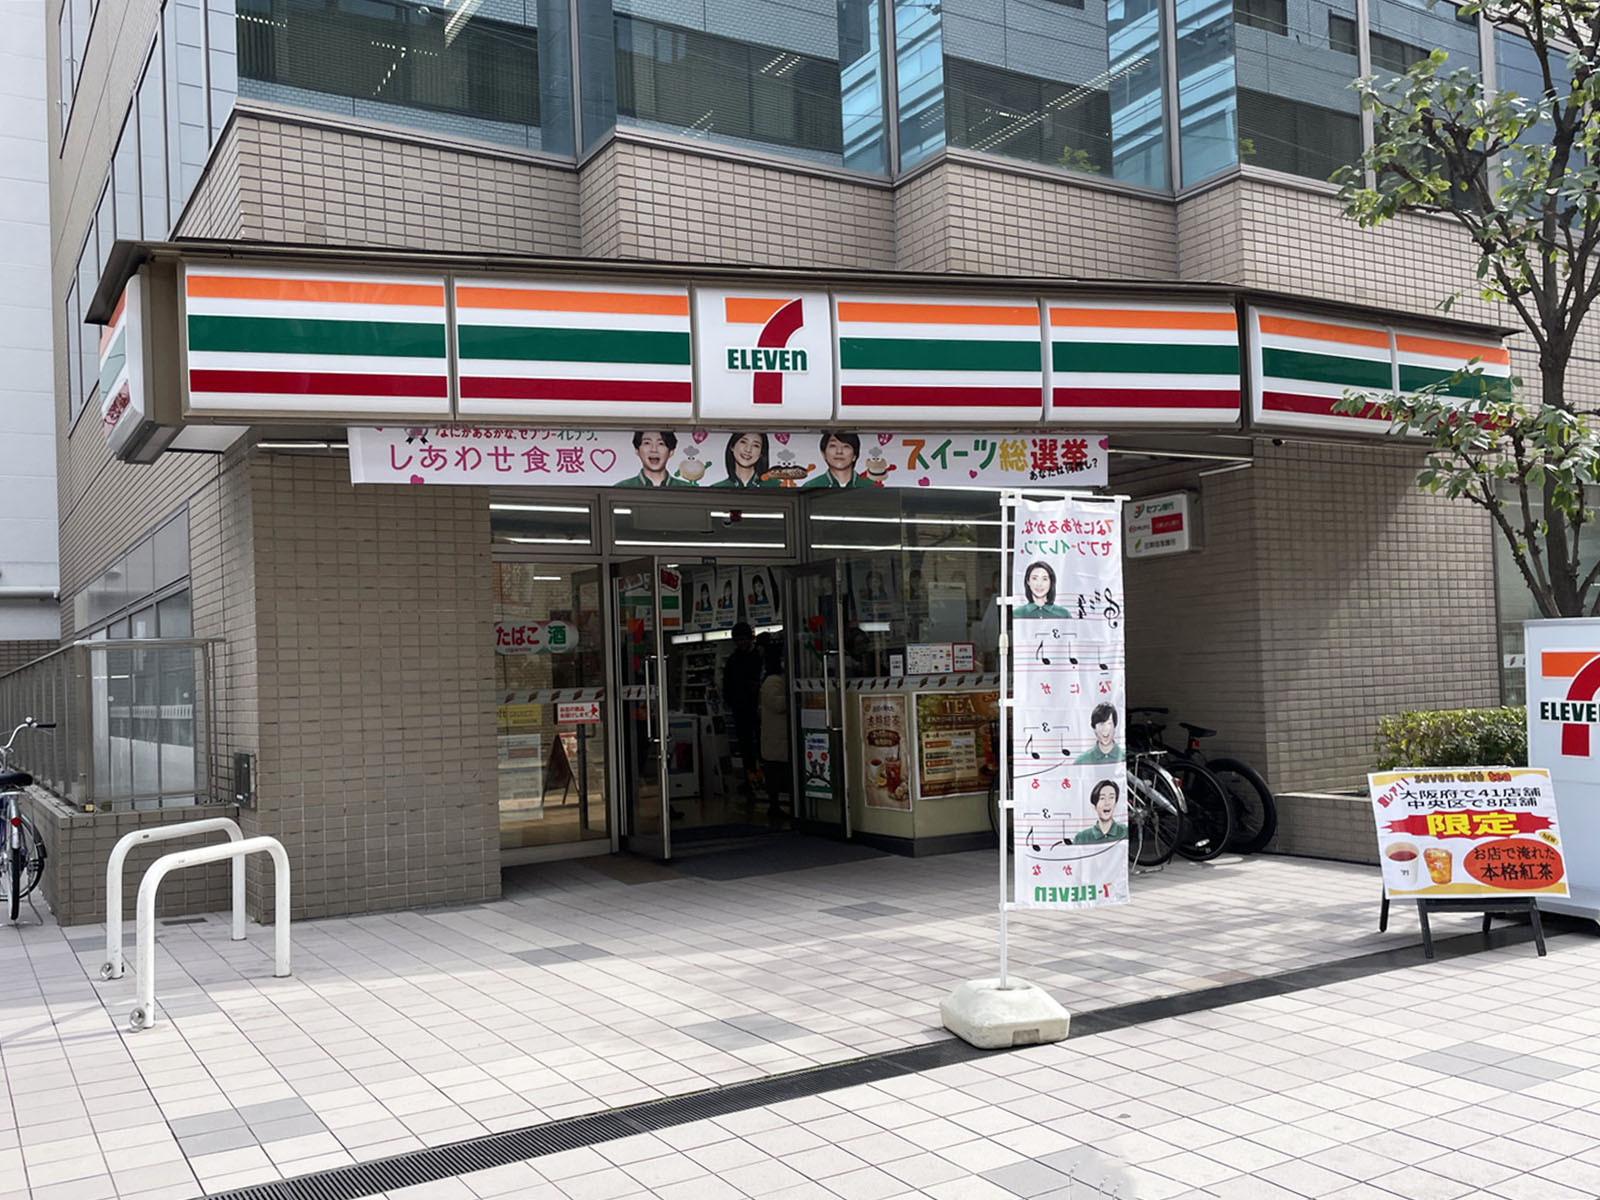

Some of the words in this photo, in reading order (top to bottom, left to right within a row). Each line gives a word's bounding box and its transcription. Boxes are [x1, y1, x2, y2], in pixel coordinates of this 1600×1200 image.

[389, 444, 585, 473] しあわせ食感
[902, 437, 1088, 472] スイーツ総選挙
[496, 626, 539, 646] たばこ
[548, 626, 566, 644] 酒
[942, 698, 976, 713] TEA
[1540, 702, 1600, 722] ELEVE
[1400, 788, 1541, 799] 大阪府で41店舗
[1407, 798, 1537, 809] 中央区で8店舗
[1426, 812, 1520, 836] 限定
[1480, 862, 1554, 881] 本格紅茶
